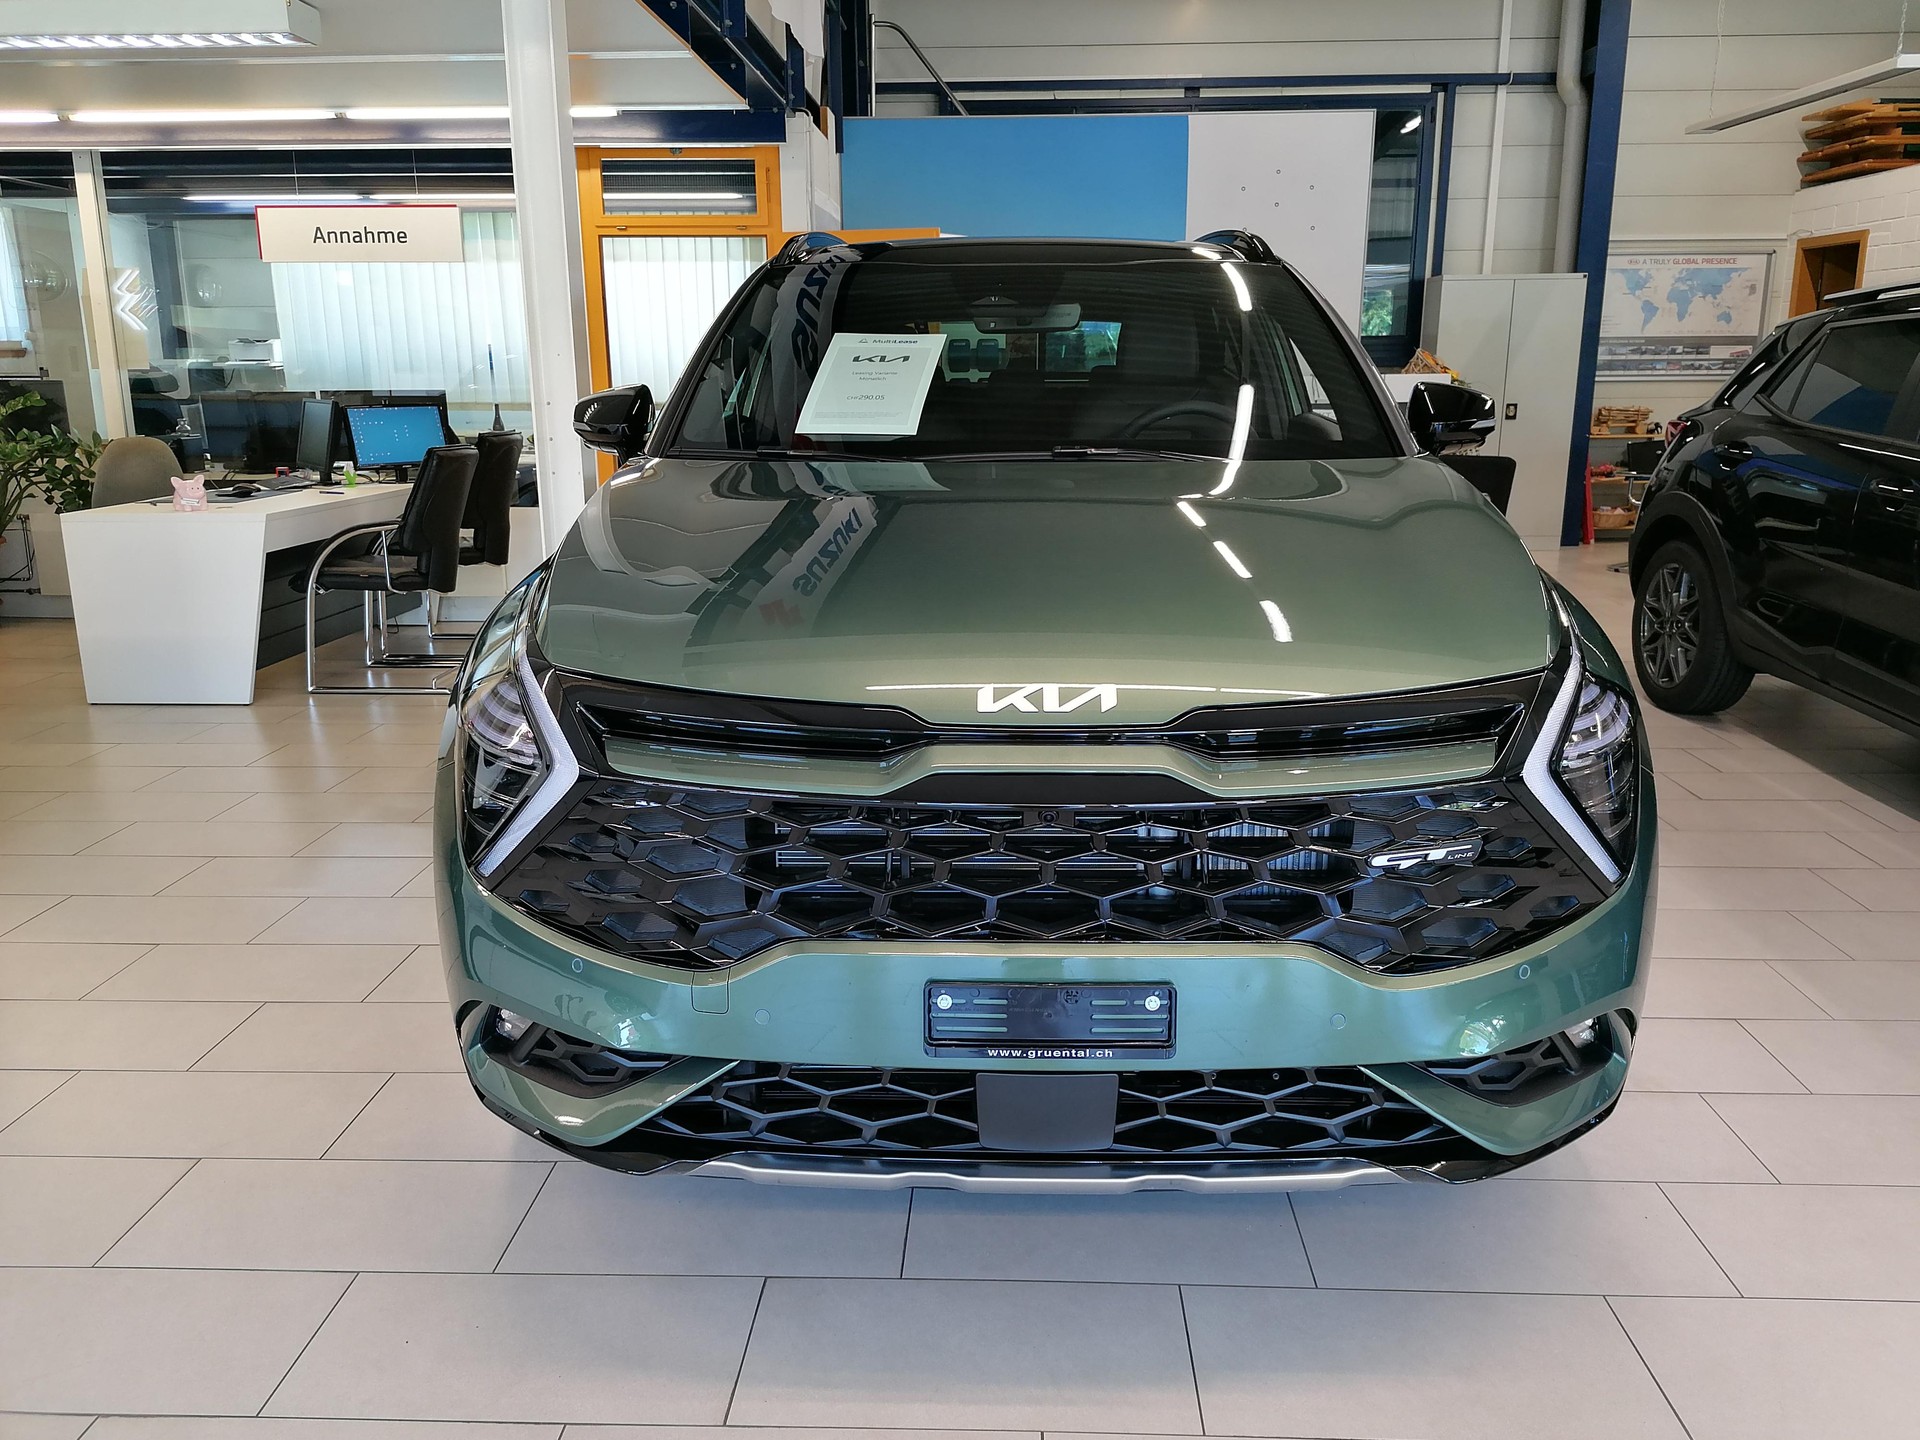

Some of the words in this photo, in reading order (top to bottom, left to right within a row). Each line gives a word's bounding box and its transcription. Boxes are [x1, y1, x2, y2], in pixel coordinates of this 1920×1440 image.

[312, 226, 408, 244] Annahme
[1701, 257, 1738, 265] PRESENCE
[976, 684, 1118, 713] KIA
[1447, 851, 1475, 860] LINE
[987, 1048, 1113, 1058] www.gruental.ch
